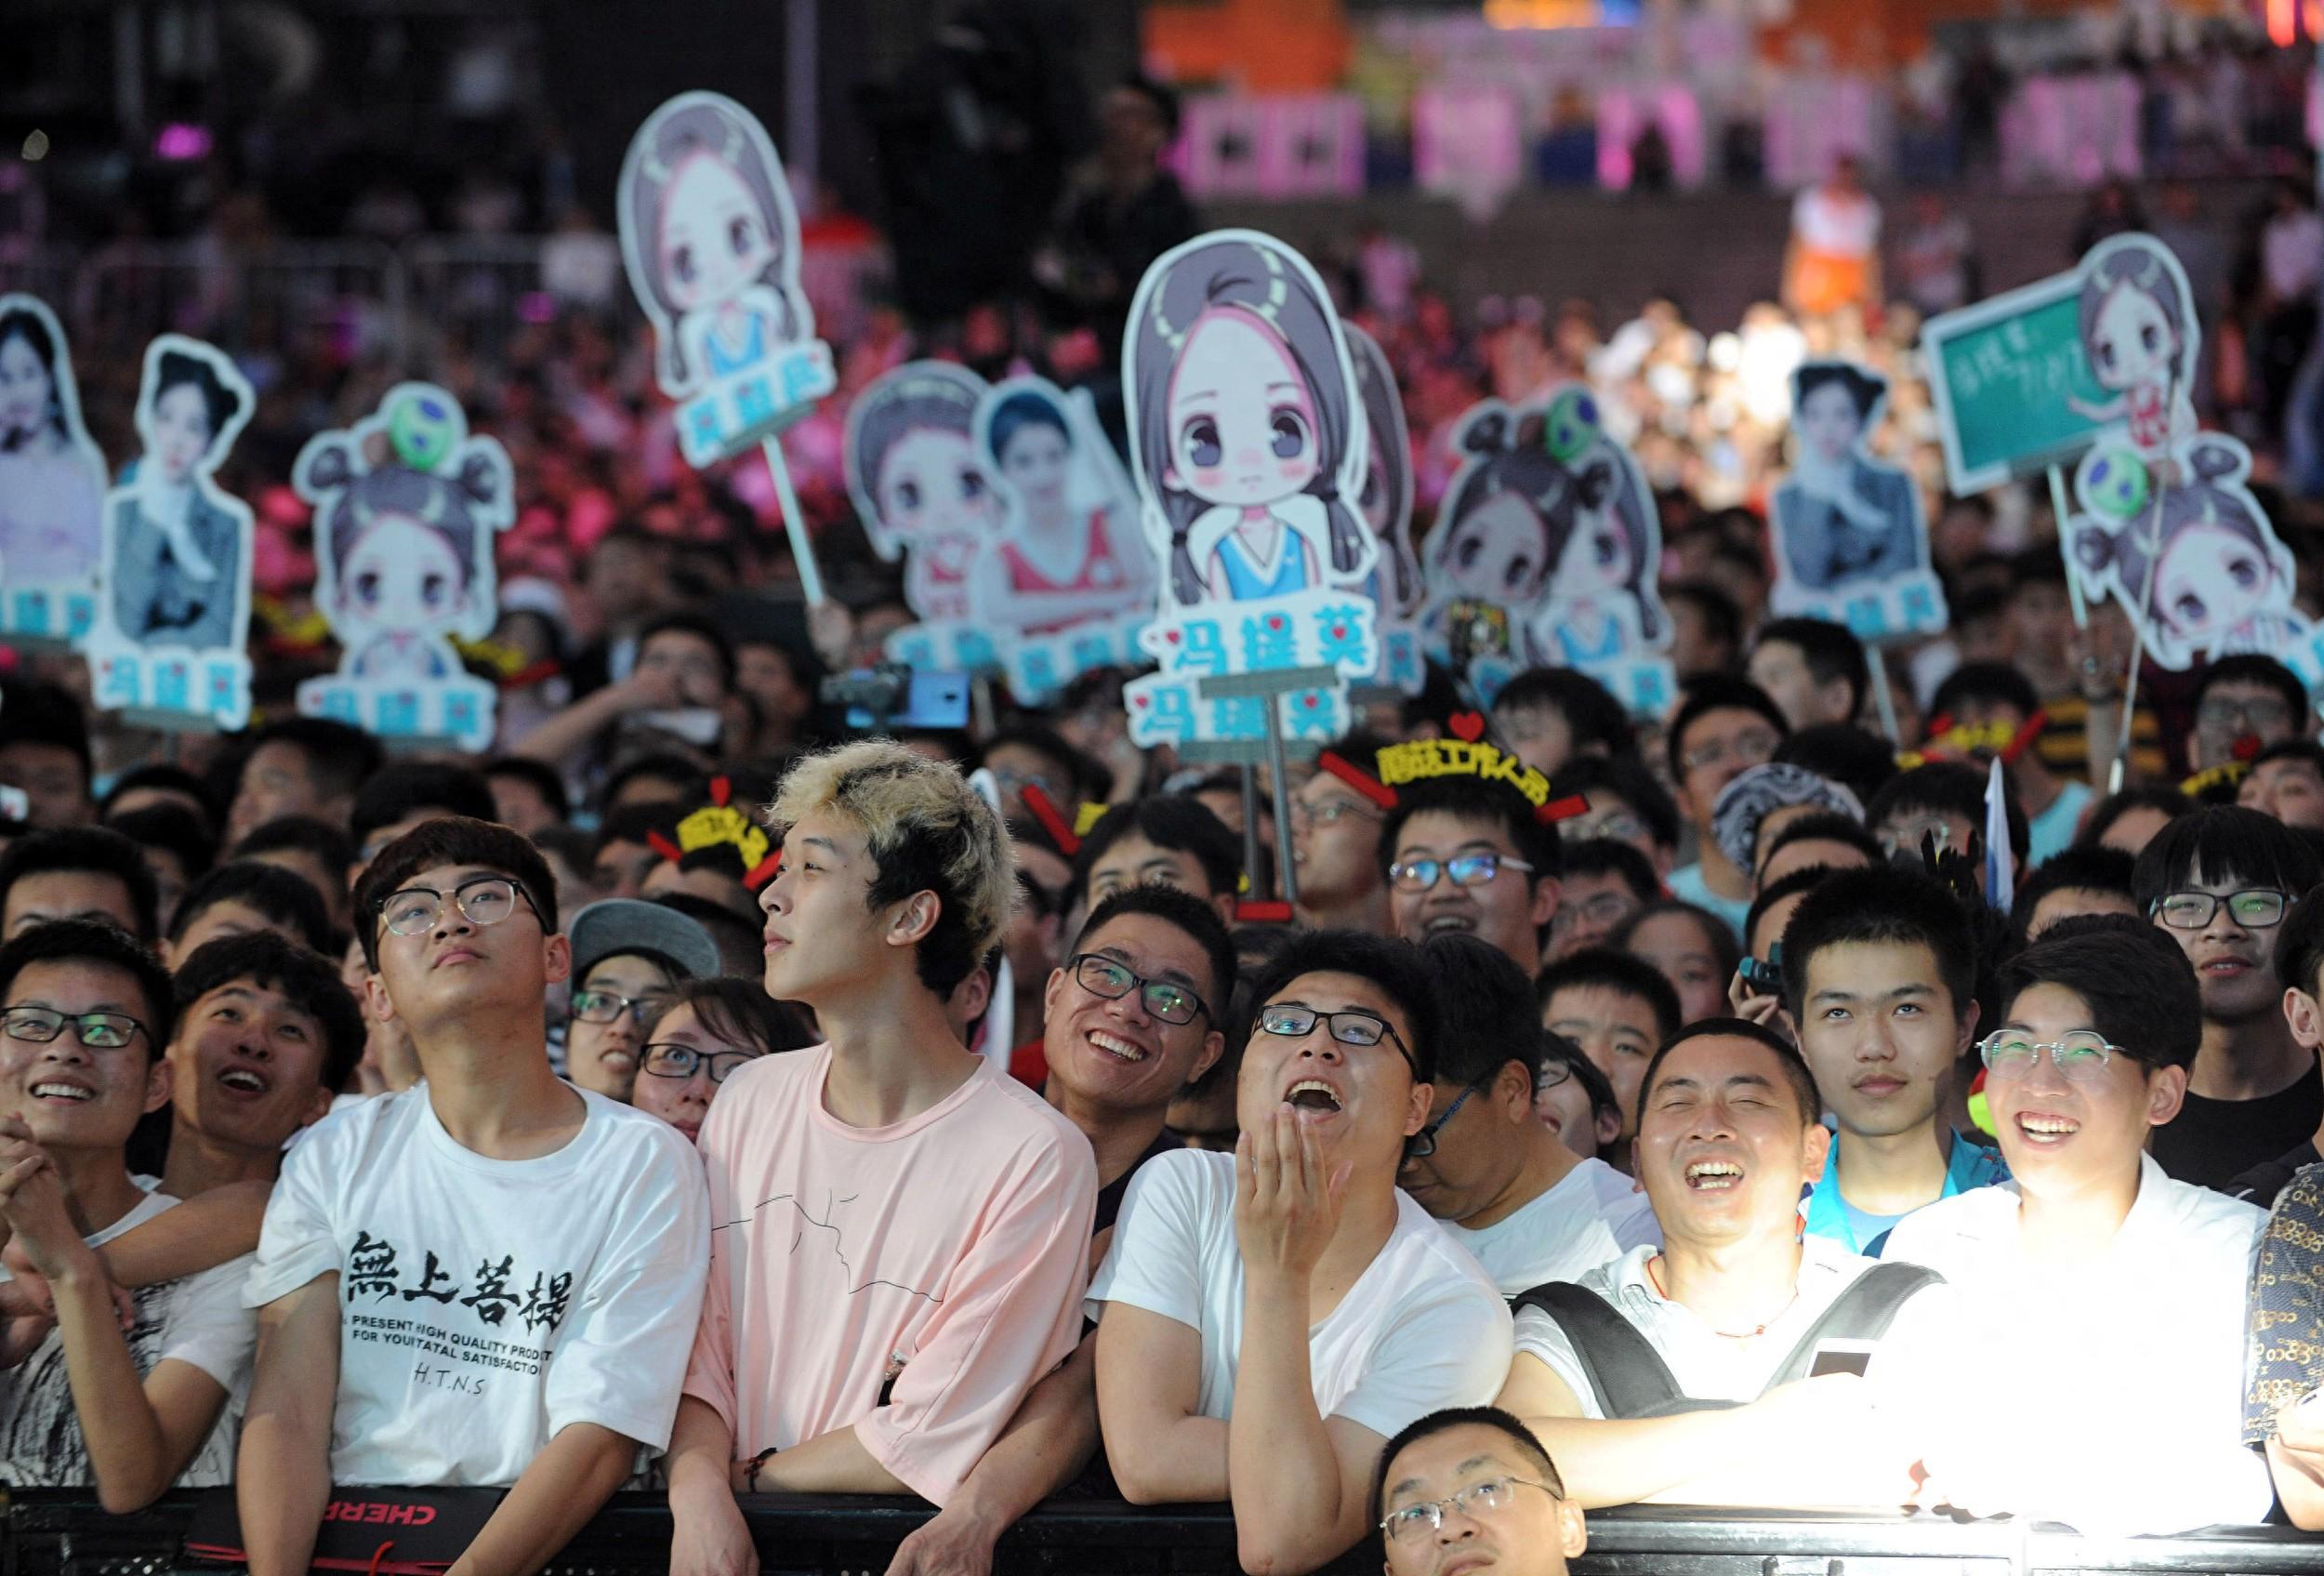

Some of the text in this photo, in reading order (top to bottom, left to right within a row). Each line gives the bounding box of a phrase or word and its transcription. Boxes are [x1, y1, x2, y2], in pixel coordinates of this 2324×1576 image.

[348, 1230, 572, 1336] 無上菩提
[351, 1315, 414, 1331] PRESENT
[450, 1333, 508, 1354] QUALITY
[352, 1330, 378, 1342] FOR
[416, 1337, 457, 1358] TATAL
[412, 1361, 485, 1395] H.T.N.S
